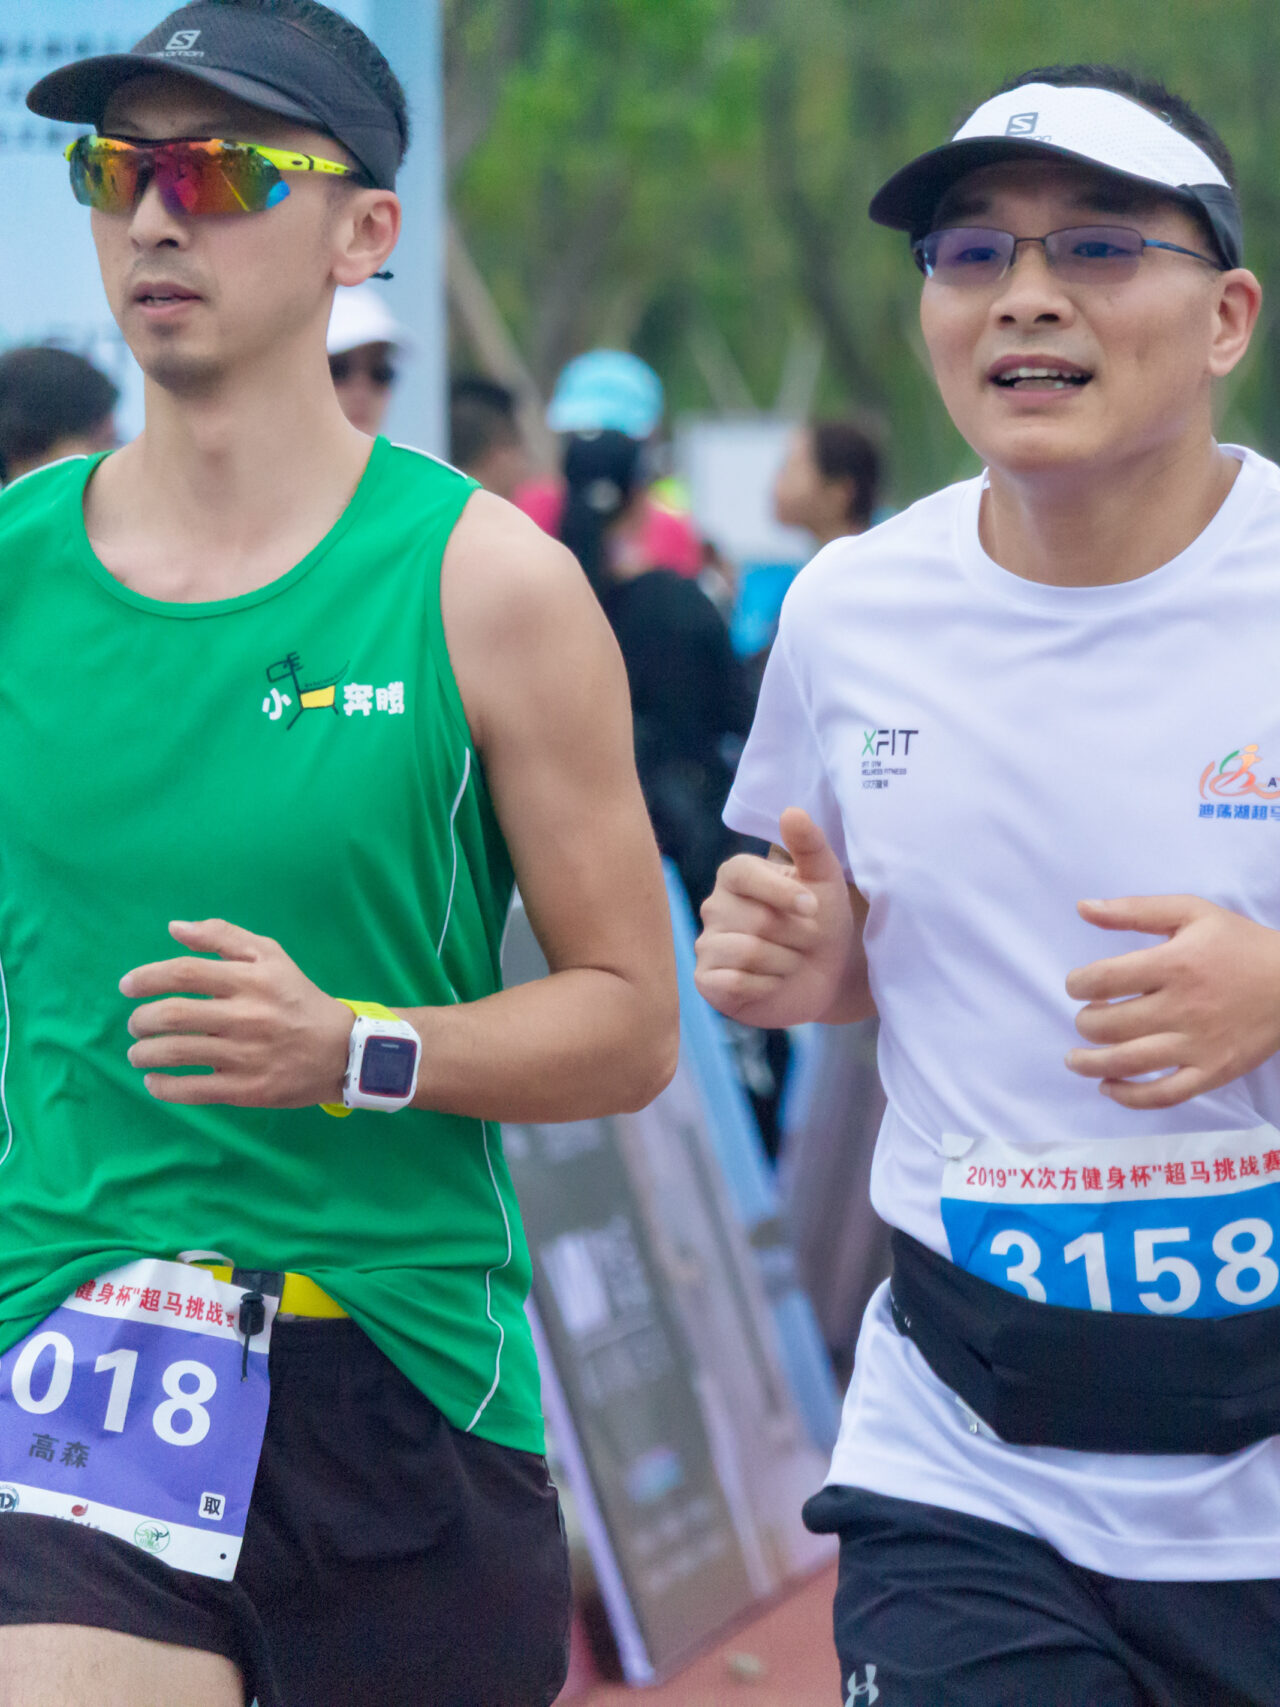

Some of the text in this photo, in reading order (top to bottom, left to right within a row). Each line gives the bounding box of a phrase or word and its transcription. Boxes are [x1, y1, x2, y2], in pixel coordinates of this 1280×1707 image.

[262, 688, 292, 721] 小
[862, 729, 919, 756] XFIT
[989, 1217, 1280, 1315] 3158
[0, 1330, 217, 1447] 018
[29, 1432, 91, 1469] 高森
[203, 1496, 221, 1516] 取
